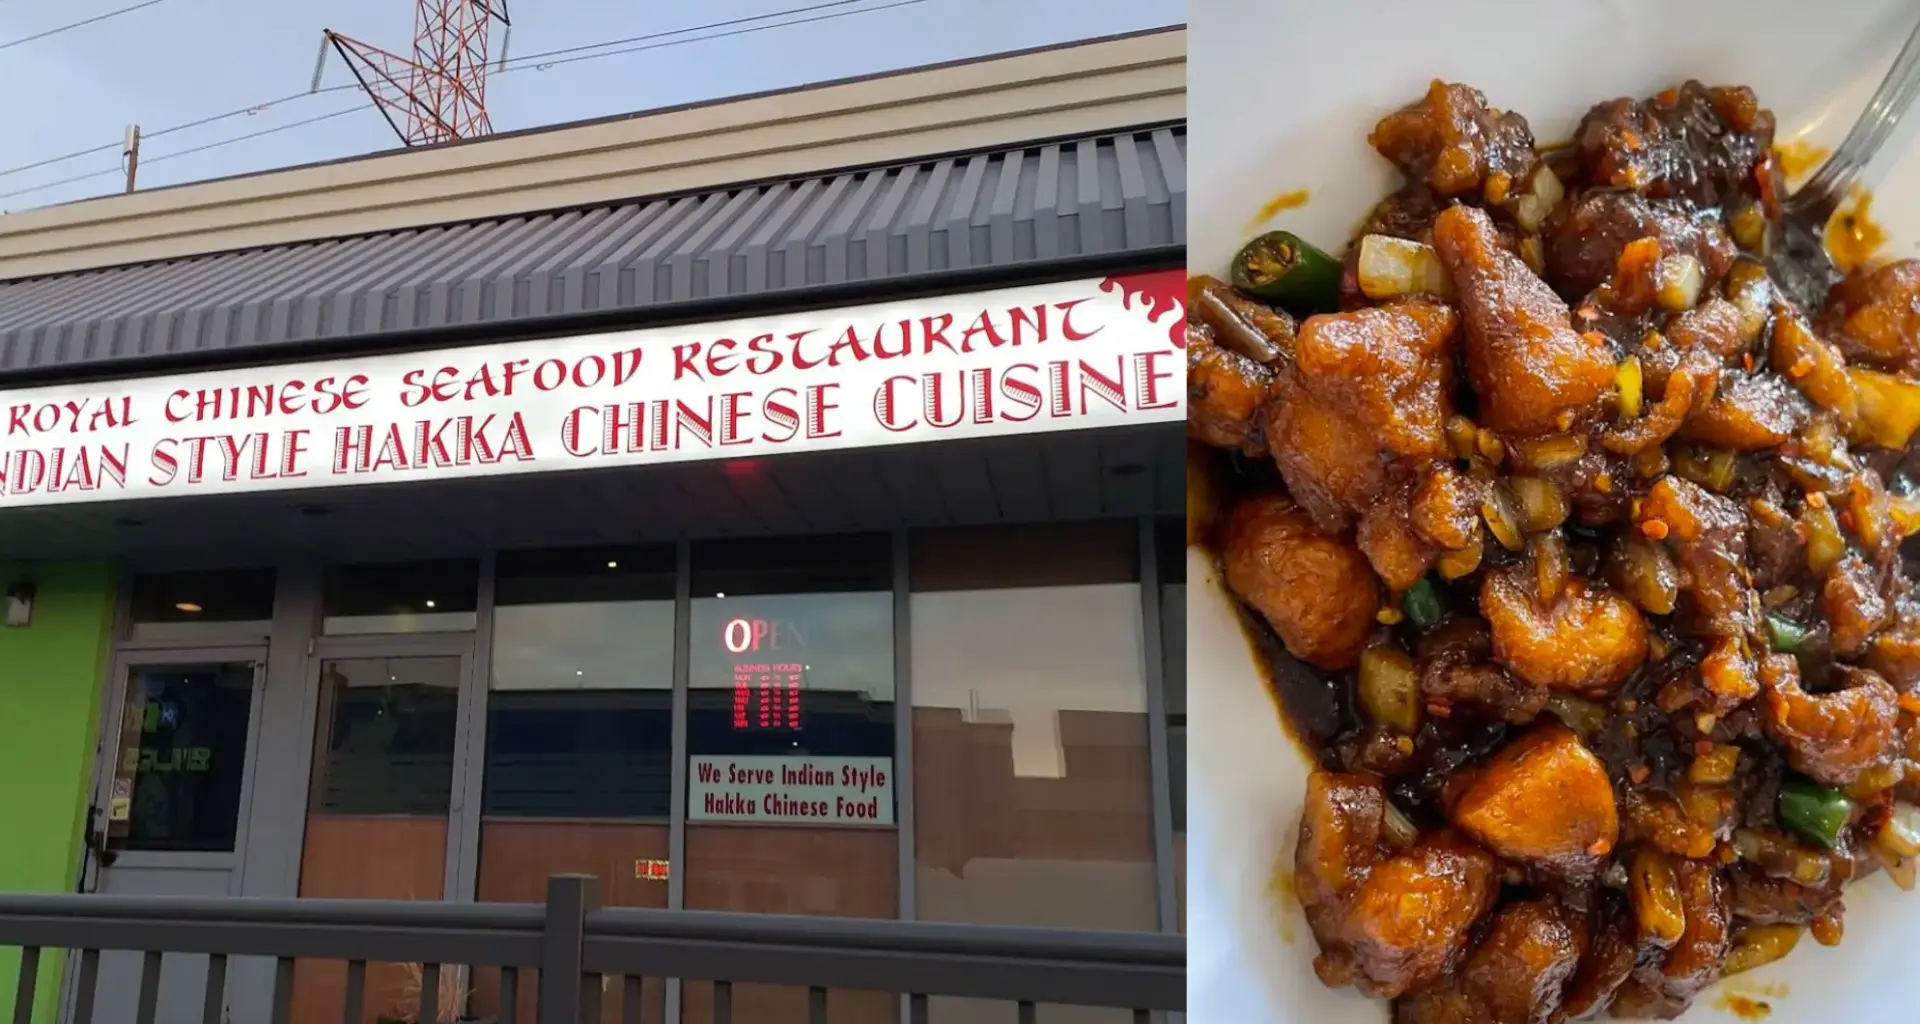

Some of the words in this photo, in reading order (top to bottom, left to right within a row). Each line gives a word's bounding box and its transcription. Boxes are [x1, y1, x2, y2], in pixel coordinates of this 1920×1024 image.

[8, 394, 138, 437] ROYAL
[165, 374, 371, 424] CHINESE
[400, 347, 642, 407] SEAFOOD
[673, 296, 1106, 381] RESTAURANT
[0, 442, 130, 497] DIAN
[148, 429, 311, 487] STYLE
[332, 411, 535, 475] HAKKA
[561, 383, 842, 457] CHINESE
[873, 350, 1178, 432] CUISINE
[724, 618, 807, 653] OPEN
[698, 762, 721, 784] We
[728, 763, 774, 785] Serve
[782, 764, 834, 786] Indian
[842, 764, 886, 794] Style
[704, 792, 756, 815] Hakka
[763, 793, 829, 817] Chinese
[836, 796, 878, 819] Food
